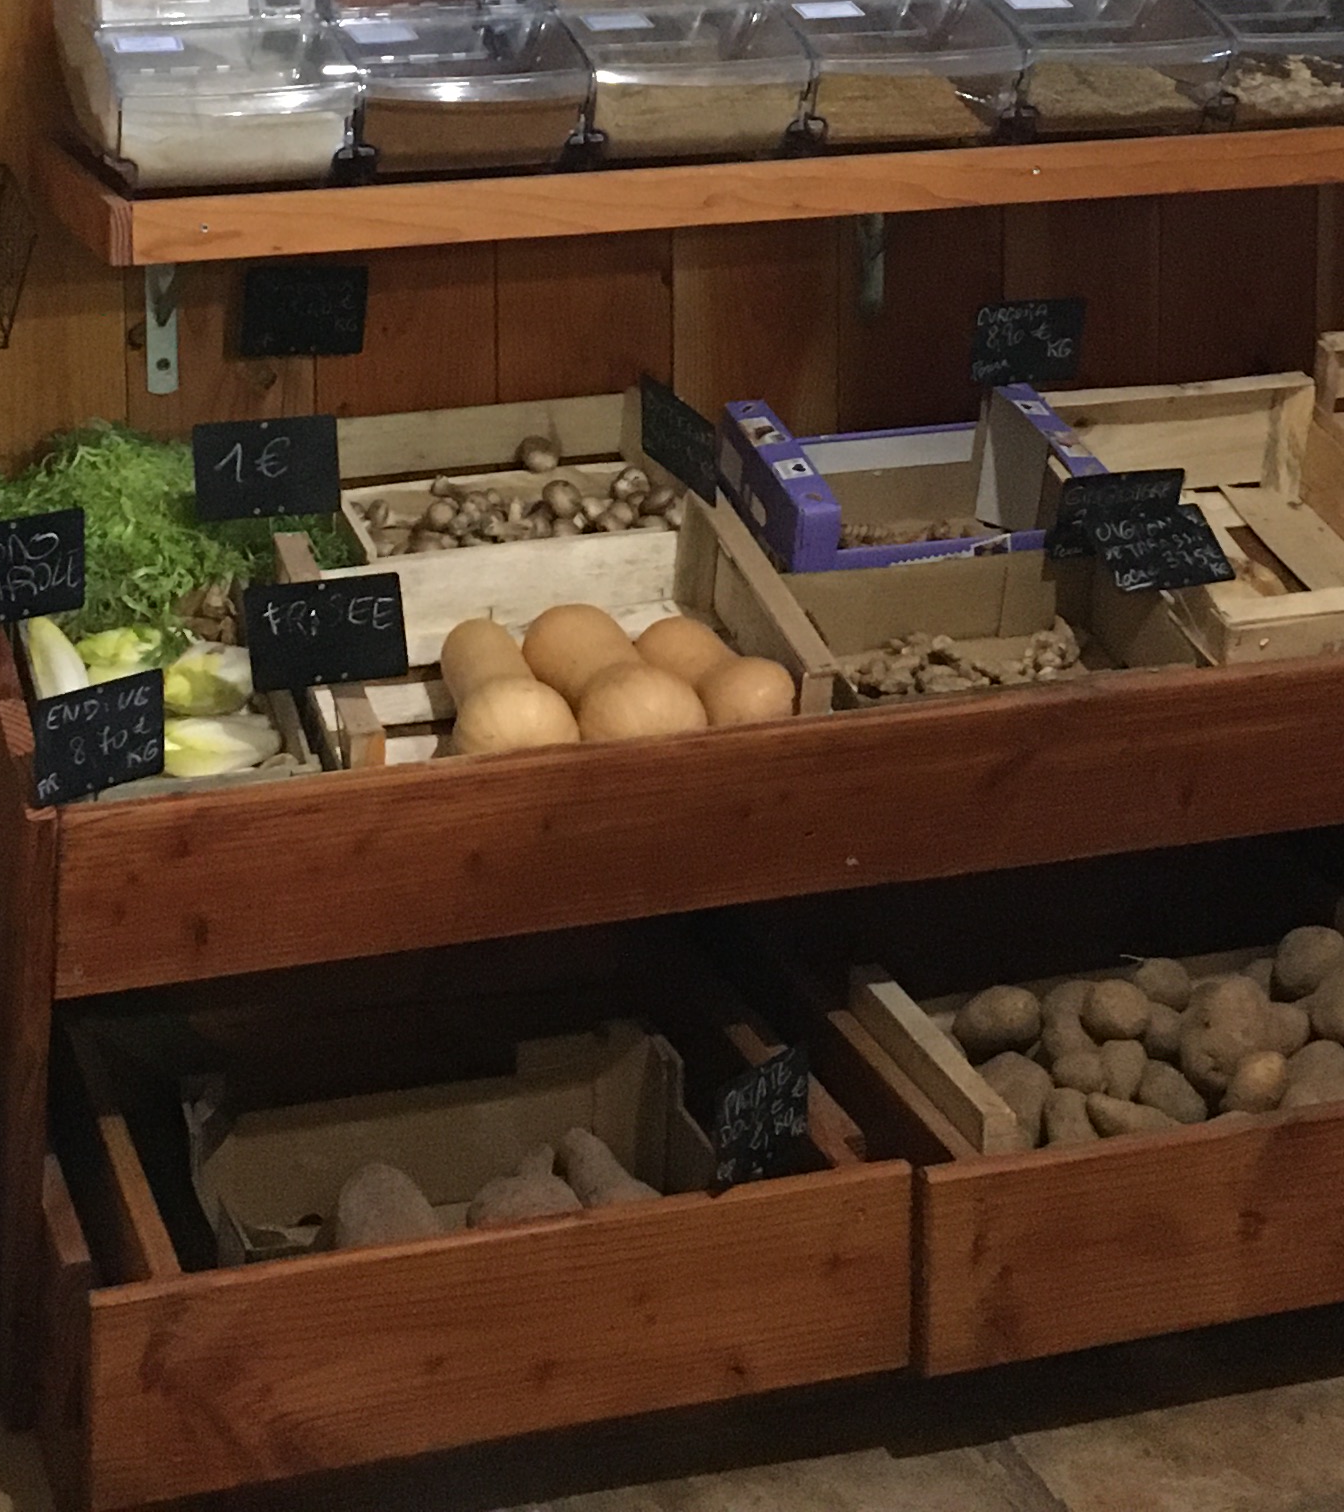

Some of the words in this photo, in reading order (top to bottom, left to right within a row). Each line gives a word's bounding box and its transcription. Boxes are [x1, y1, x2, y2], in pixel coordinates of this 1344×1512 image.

[1047, 338, 1073, 358] KG
[214, 442, 243, 483] 1
[254, 437, 291, 478] €
[127, 739, 159, 768] KG
[37, 773, 59, 799] FR
